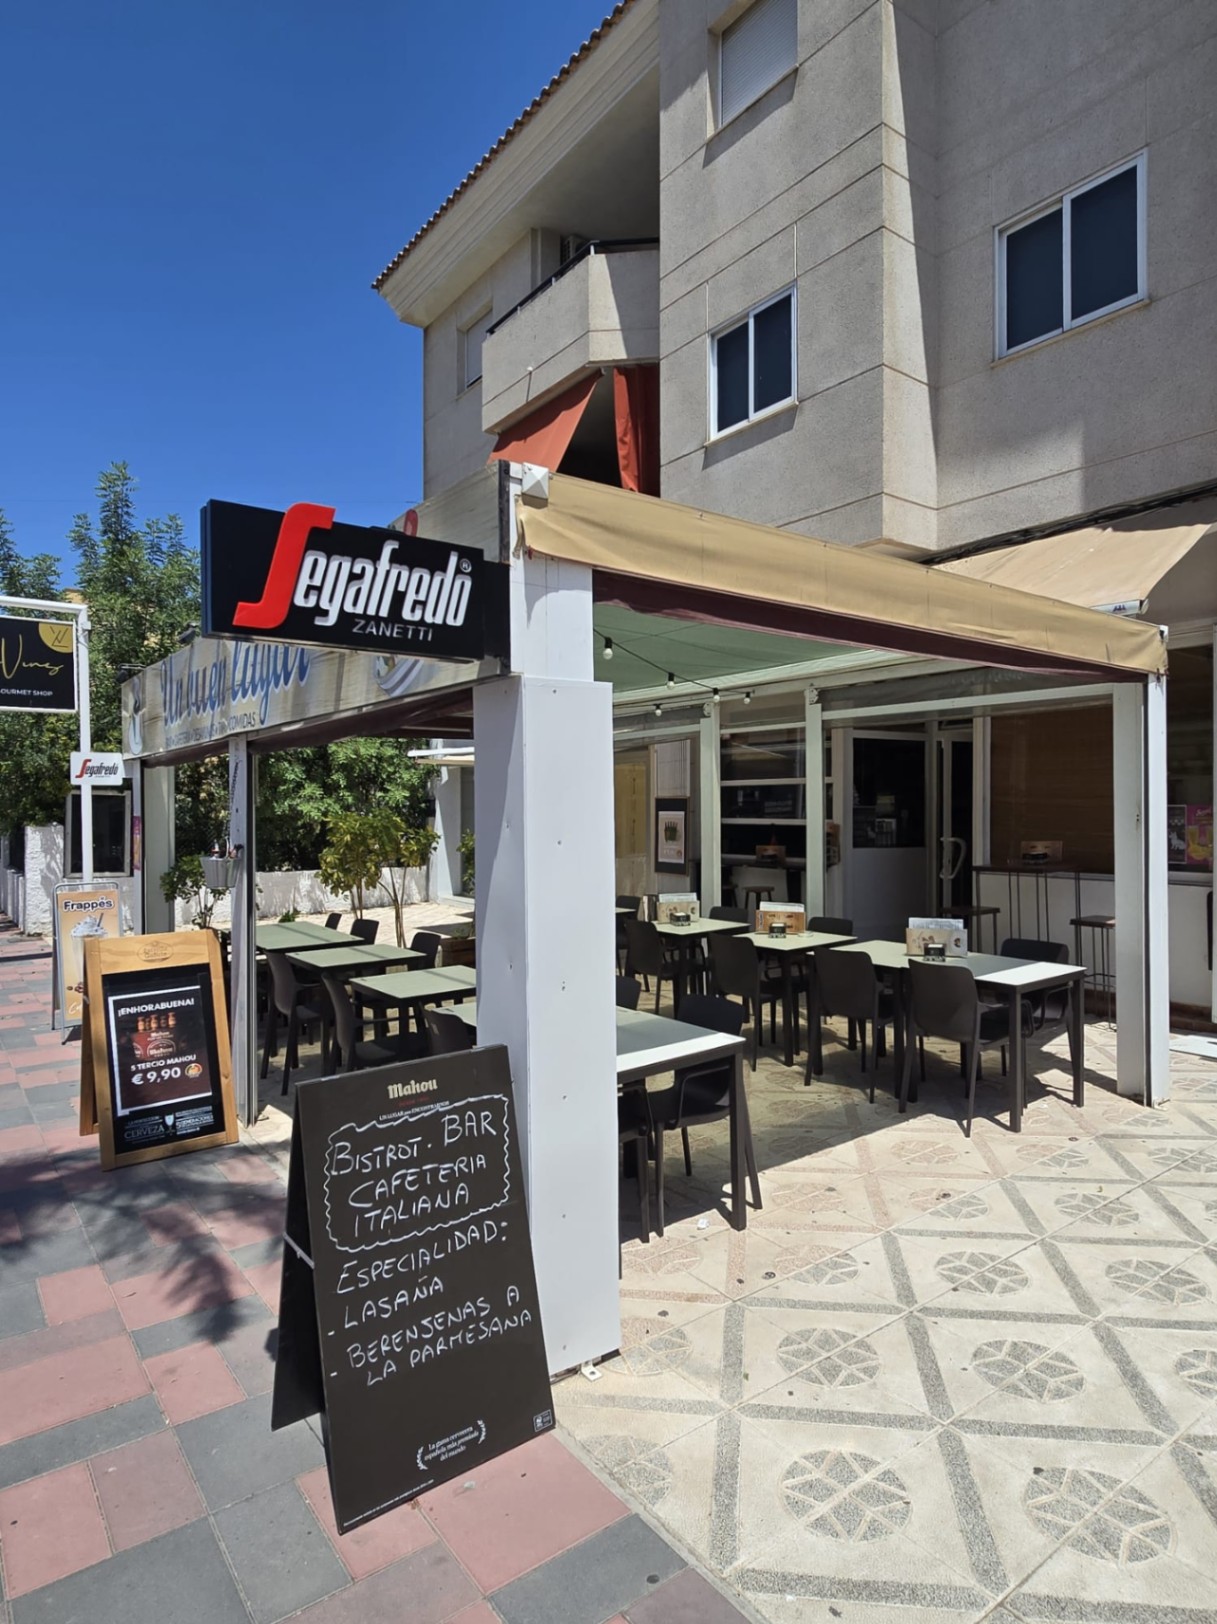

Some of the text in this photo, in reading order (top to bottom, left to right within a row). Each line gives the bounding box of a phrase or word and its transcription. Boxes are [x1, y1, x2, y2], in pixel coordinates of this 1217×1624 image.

[233, 502, 472, 629] Segafredo
[352, 618, 433, 641] ZANETTI
[0, 688, 53, 697] OURMET SHOP
[75, 759, 119, 778] Segafredo
[64, 896, 113, 912] Frappés
[118, 998, 195, 1017] ¡ENHORABUENA!
[137, 1060, 165, 1070] TERCIO
[166, 1054, 197, 1065] MAHOU
[146, 1067, 181, 1083] 9,90
[387, 1079, 438, 1099] Mahou
[441, 1111, 497, 1147] BAR
[348, 1154, 486, 1208] CAFETERIA
[354, 1182, 469, 1238] ITALIANA
[337, 1220, 508, 1294] ESPECIALIDAD:
[344, 1275, 444, 1330] LASAÑA
[506, 1285, 520, 1306] A
[366, 1309, 532, 1387] LA PARMESANA
